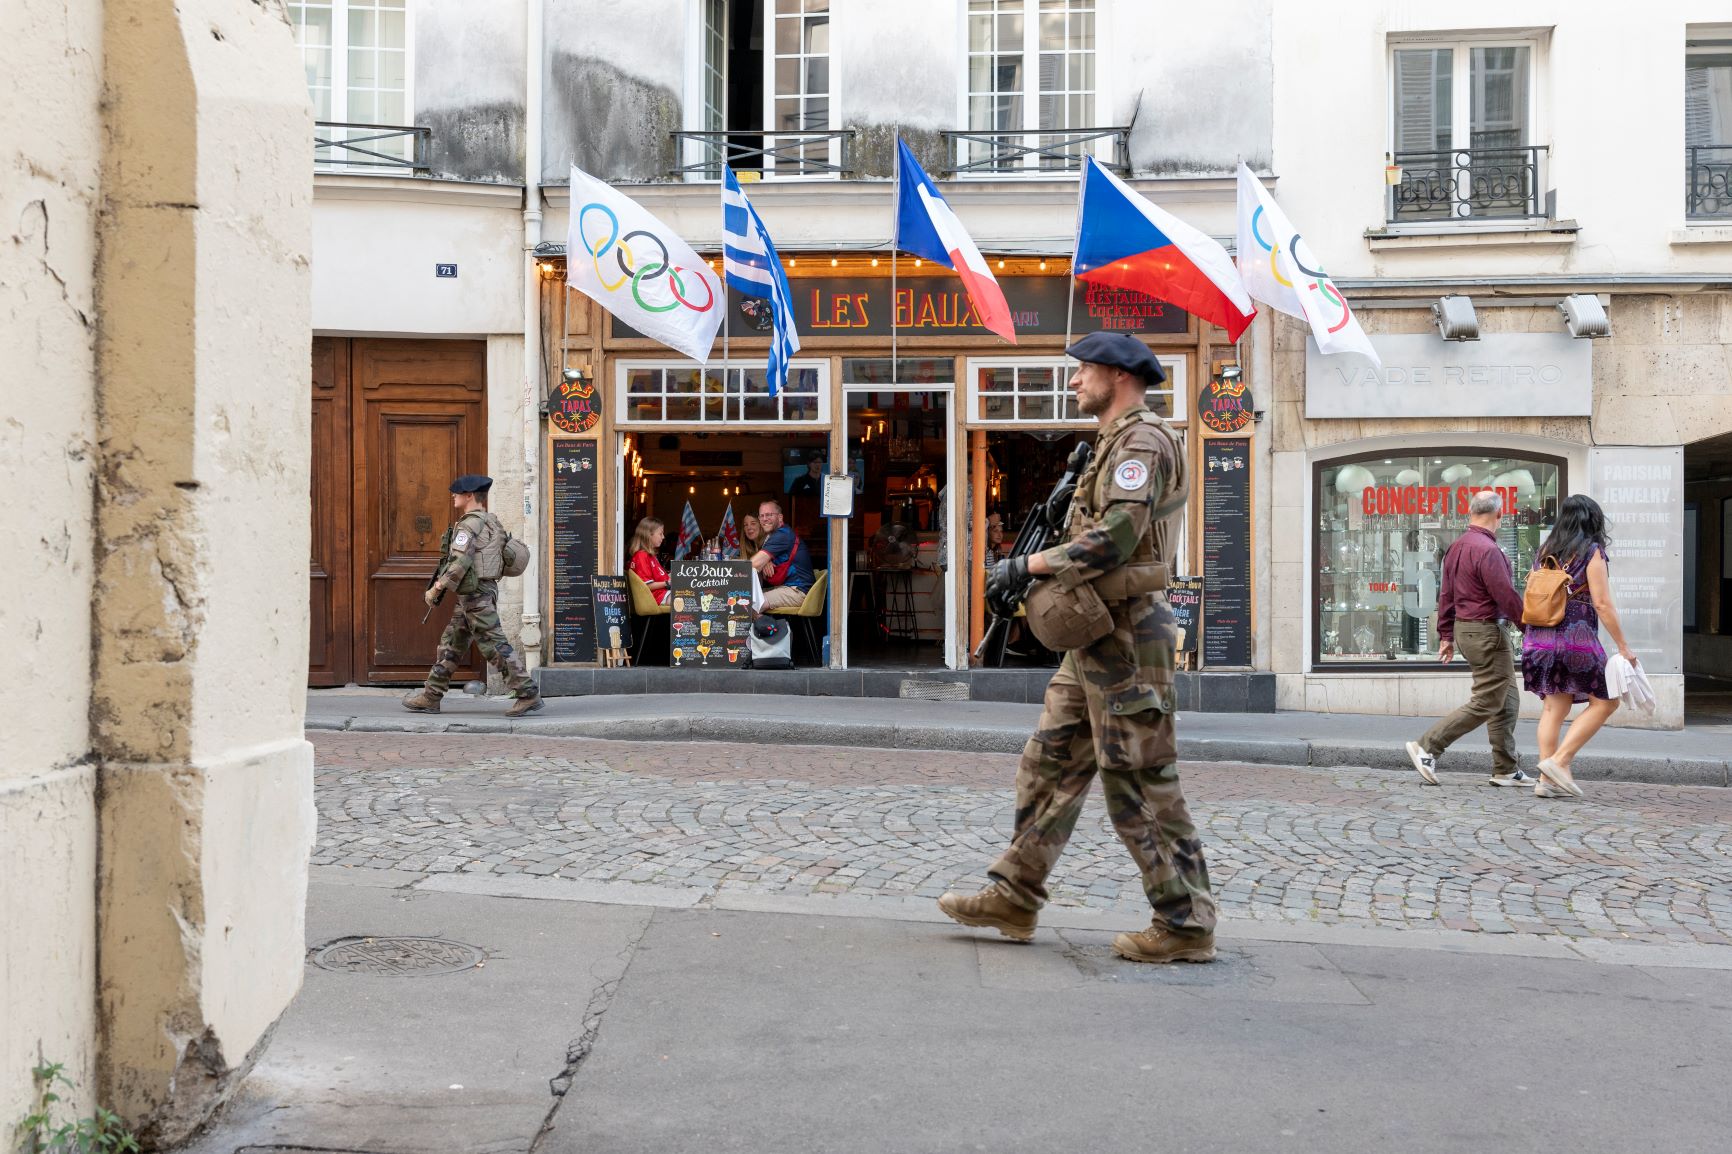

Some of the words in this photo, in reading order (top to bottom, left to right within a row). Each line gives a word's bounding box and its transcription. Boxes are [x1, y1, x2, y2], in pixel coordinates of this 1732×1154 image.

[441, 266, 452, 274] 71
[810, 288, 869, 328] LES
[891, 288, 985, 328] BAUX
[1089, 305, 1163, 317] COCKTAILS
[1012, 311, 1040, 326] ARIS
[1336, 366, 1432, 385] VADE
[1442, 365, 1562, 385] RETRO
[560, 381, 594, 397] BAR
[1210, 379, 1246, 397] BAR
[560, 400, 592, 412] TAPAS
[1210, 398, 1242, 412] TAPAS
[1604, 464, 1672, 480] PARISIAN
[1363, 486, 1450, 515] CONCEPT
[1458, 486, 1518, 515] STRE
[1603, 488, 1670, 504] JEWELRY
[1639, 512, 1671, 522] STORE
[1614, 540, 1646, 548] SIGNERS
[677, 564, 698, 577] Les
[700, 564, 733, 578] Baux
[690, 578, 729, 588] Cocktails
[1369, 583, 1388, 592] TOUT
[1404, 552, 1436, 618] 5
